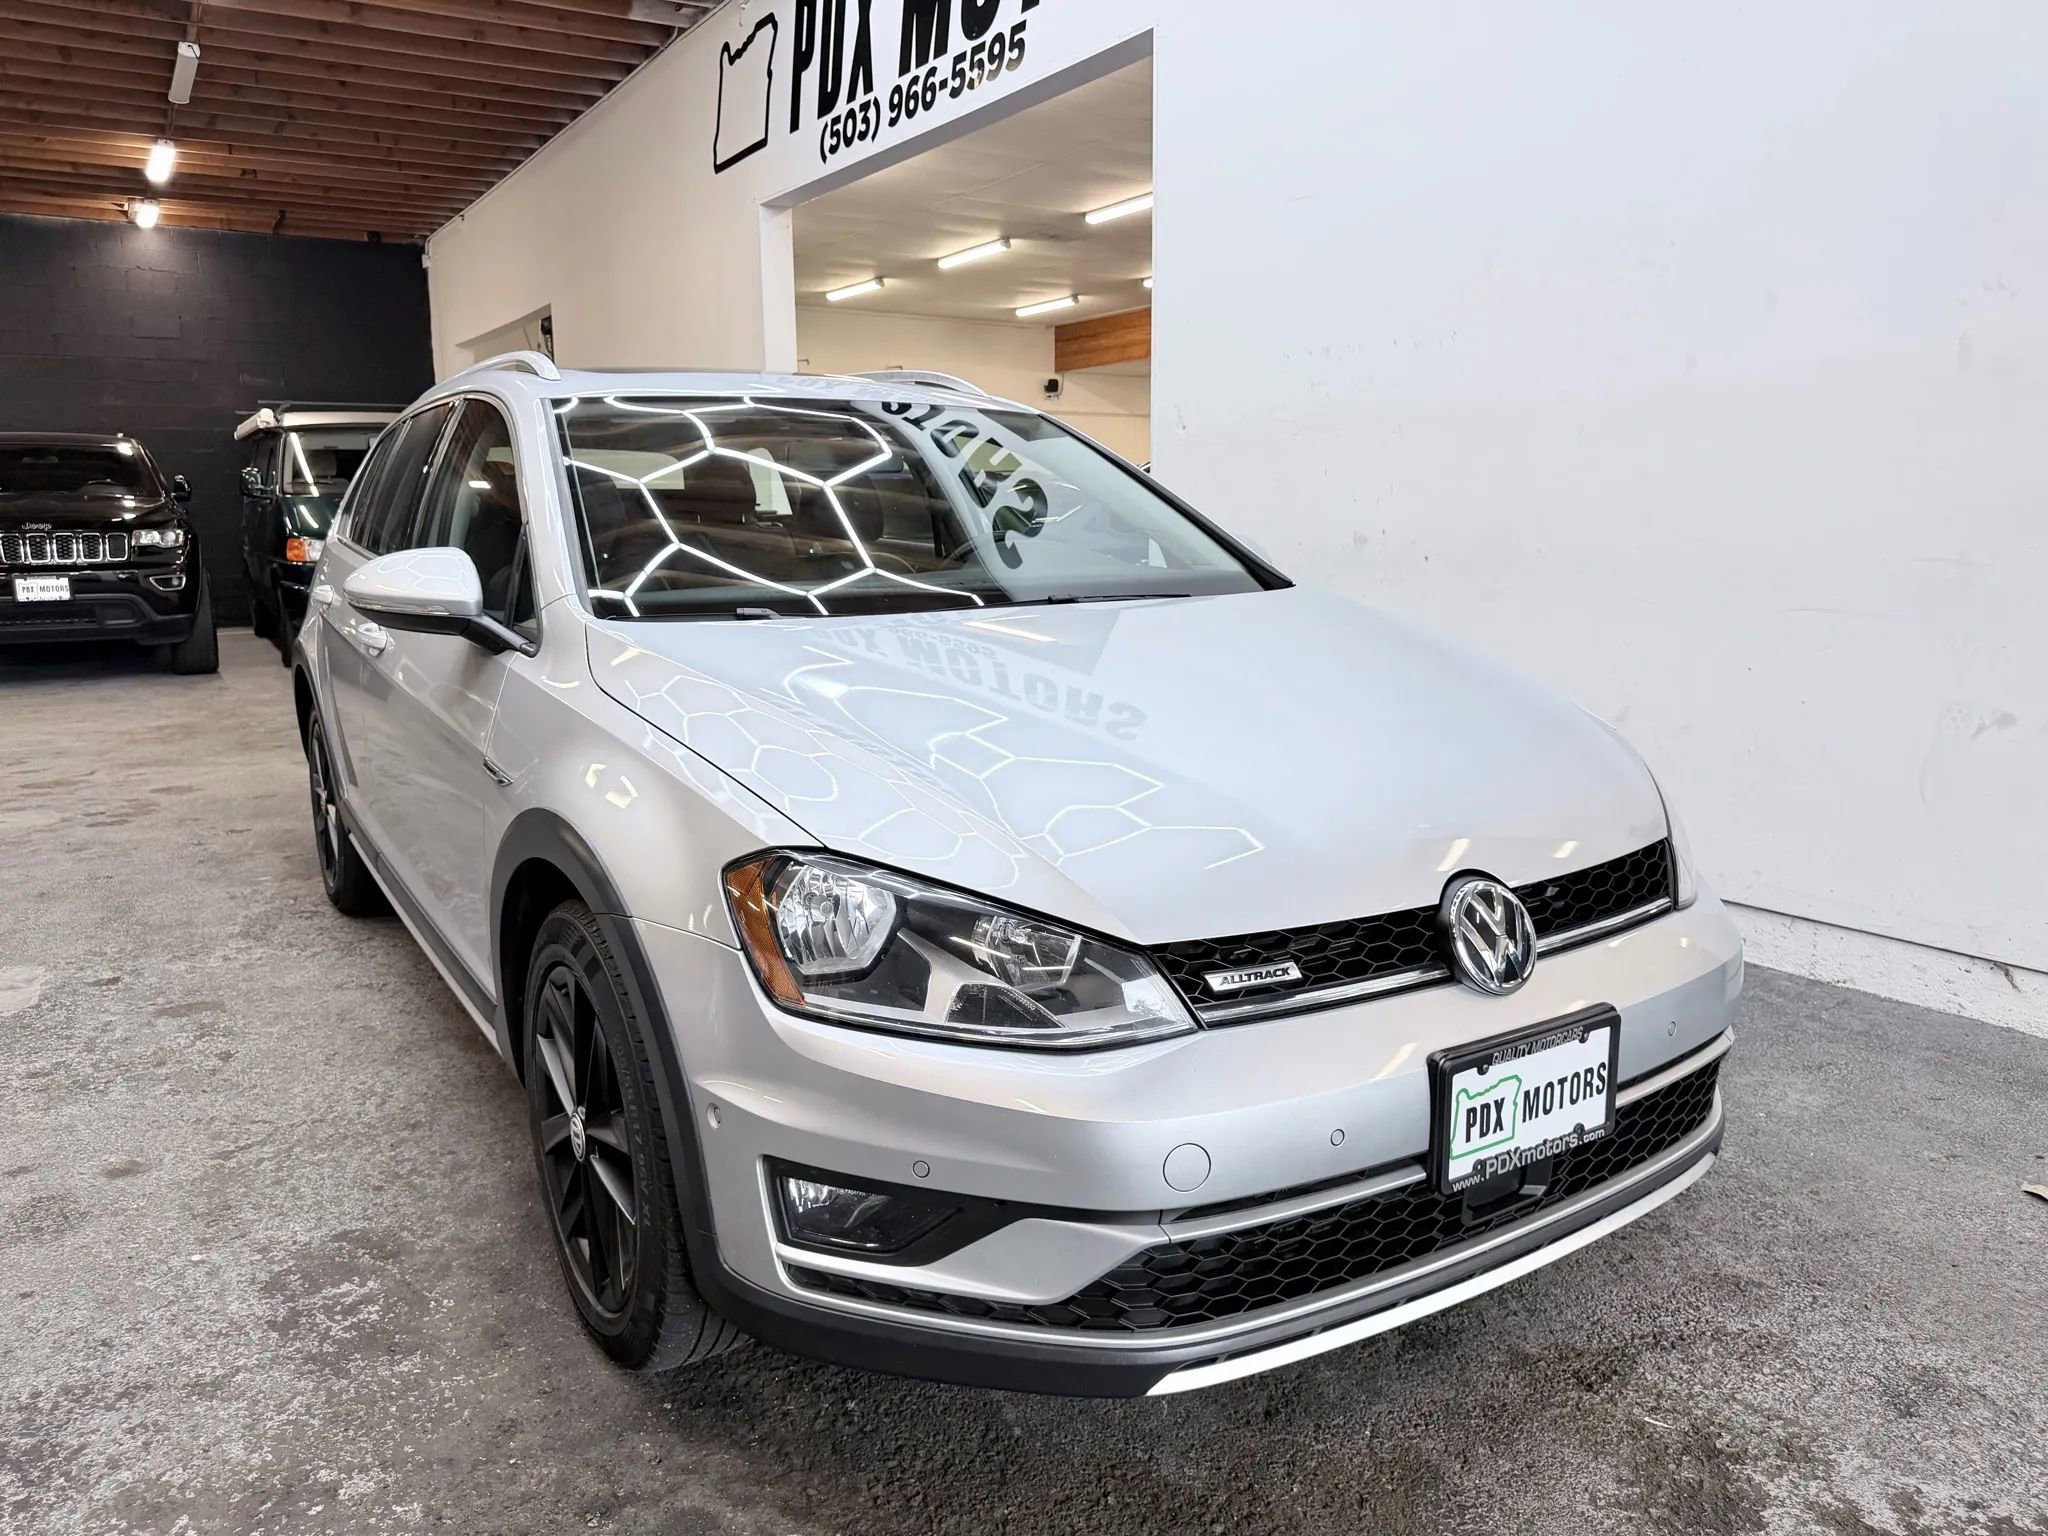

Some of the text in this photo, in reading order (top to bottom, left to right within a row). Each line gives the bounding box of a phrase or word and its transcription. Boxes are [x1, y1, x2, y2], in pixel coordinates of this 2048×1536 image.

[790, 0, 873, 134] PDX
[820, 97, 881, 164] (503)
[888, 20, 1027, 127] 966-5595
[21, 521, 52, 531] Jeep
[39, 584, 69, 593] MOTORS
[1219, 965, 1291, 987] ALLTRACK
[1492, 1026, 1584, 1065] QUALITY MOTORCARS
[1465, 1061, 1607, 1144] PDX MOTORS
[1452, 1127, 1606, 1193] www.PDXmotors.com
